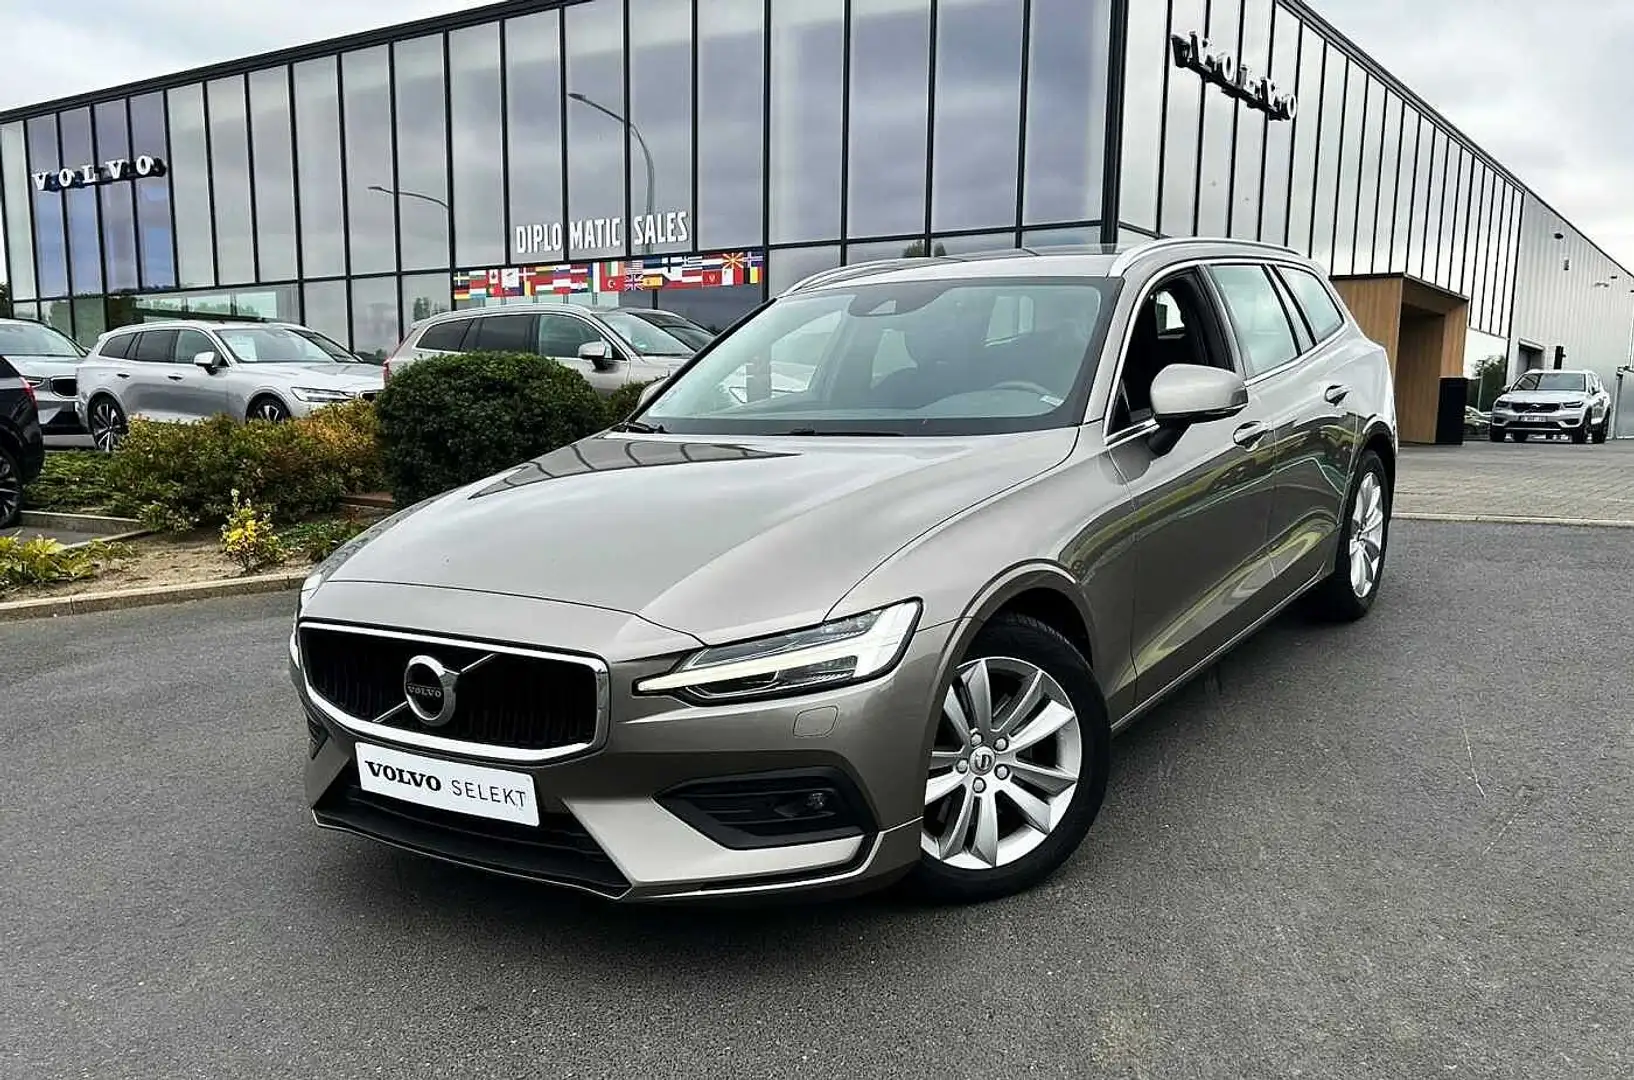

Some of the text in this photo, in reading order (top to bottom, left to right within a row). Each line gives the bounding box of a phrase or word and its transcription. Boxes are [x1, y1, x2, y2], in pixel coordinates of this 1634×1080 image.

[32, 155, 154, 191] VOLVO
[633, 211, 688, 246] SALES
[407, 685, 442, 698] VOLVO
[364, 760, 526, 808] VOLVO SELEKT
